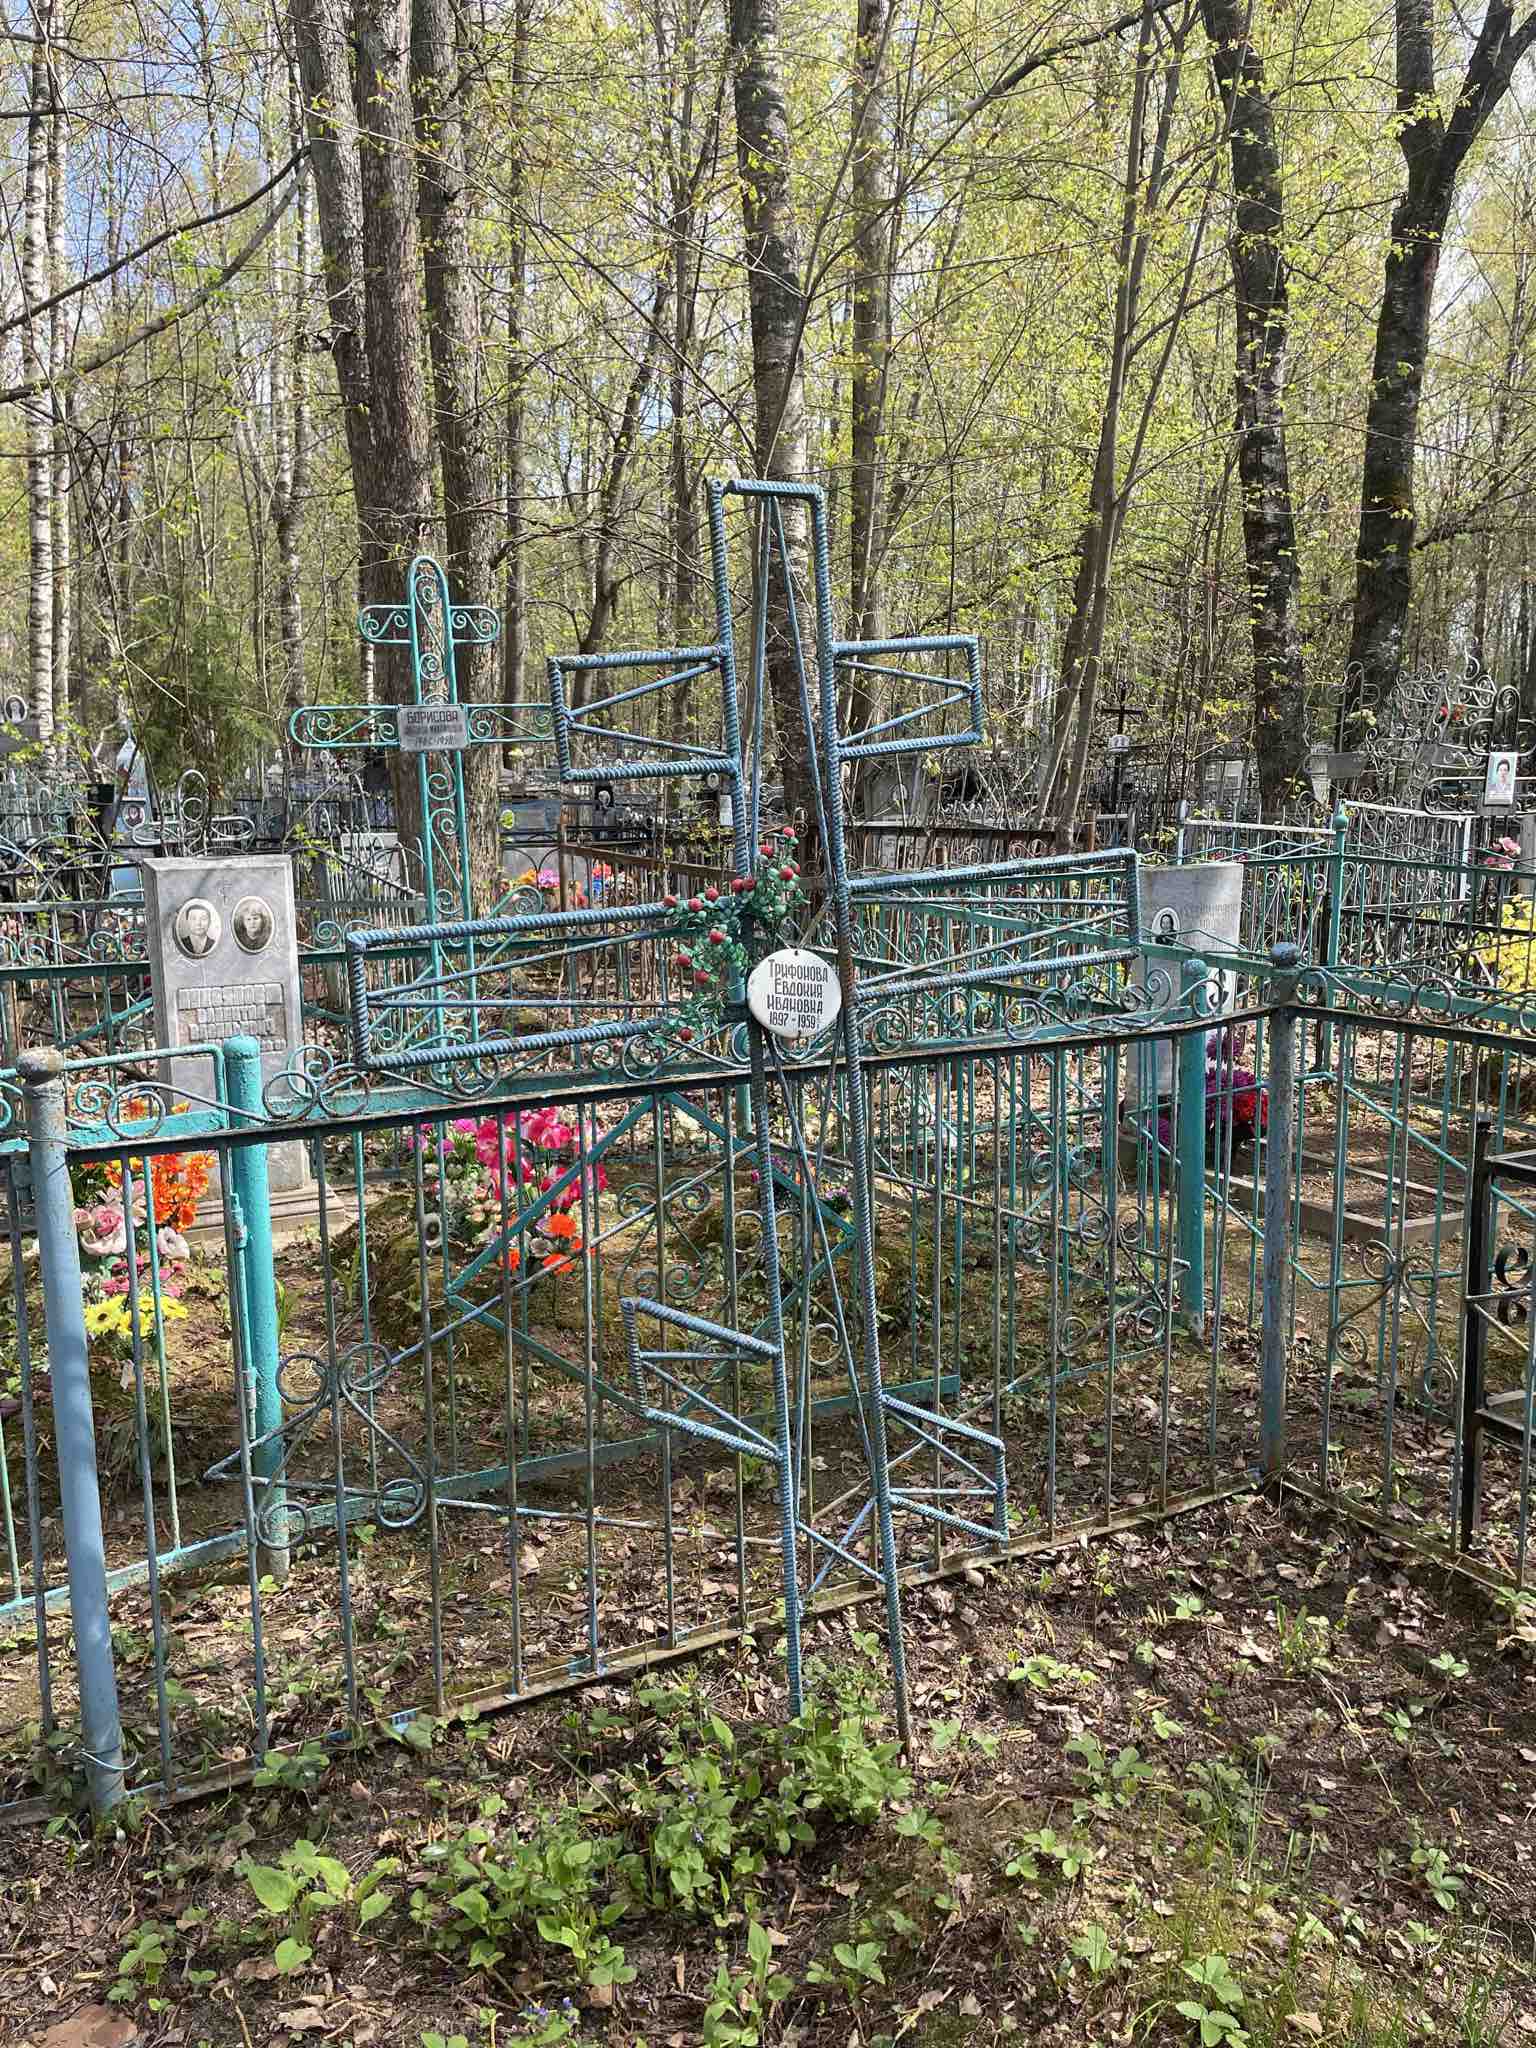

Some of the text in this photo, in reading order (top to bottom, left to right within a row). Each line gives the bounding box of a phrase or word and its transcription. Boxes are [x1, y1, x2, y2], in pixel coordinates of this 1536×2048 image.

[407, 710, 458, 724] БОРИСОВА
[768, 959, 828, 982] ТРИФОНОВА
[774, 979, 823, 998] ЕВДОКИЯ
[767, 994, 823, 1014] ИВАНОВНА
[769, 1011, 789, 1026] 1897
[798, 1014, 816, 1029] 1959
